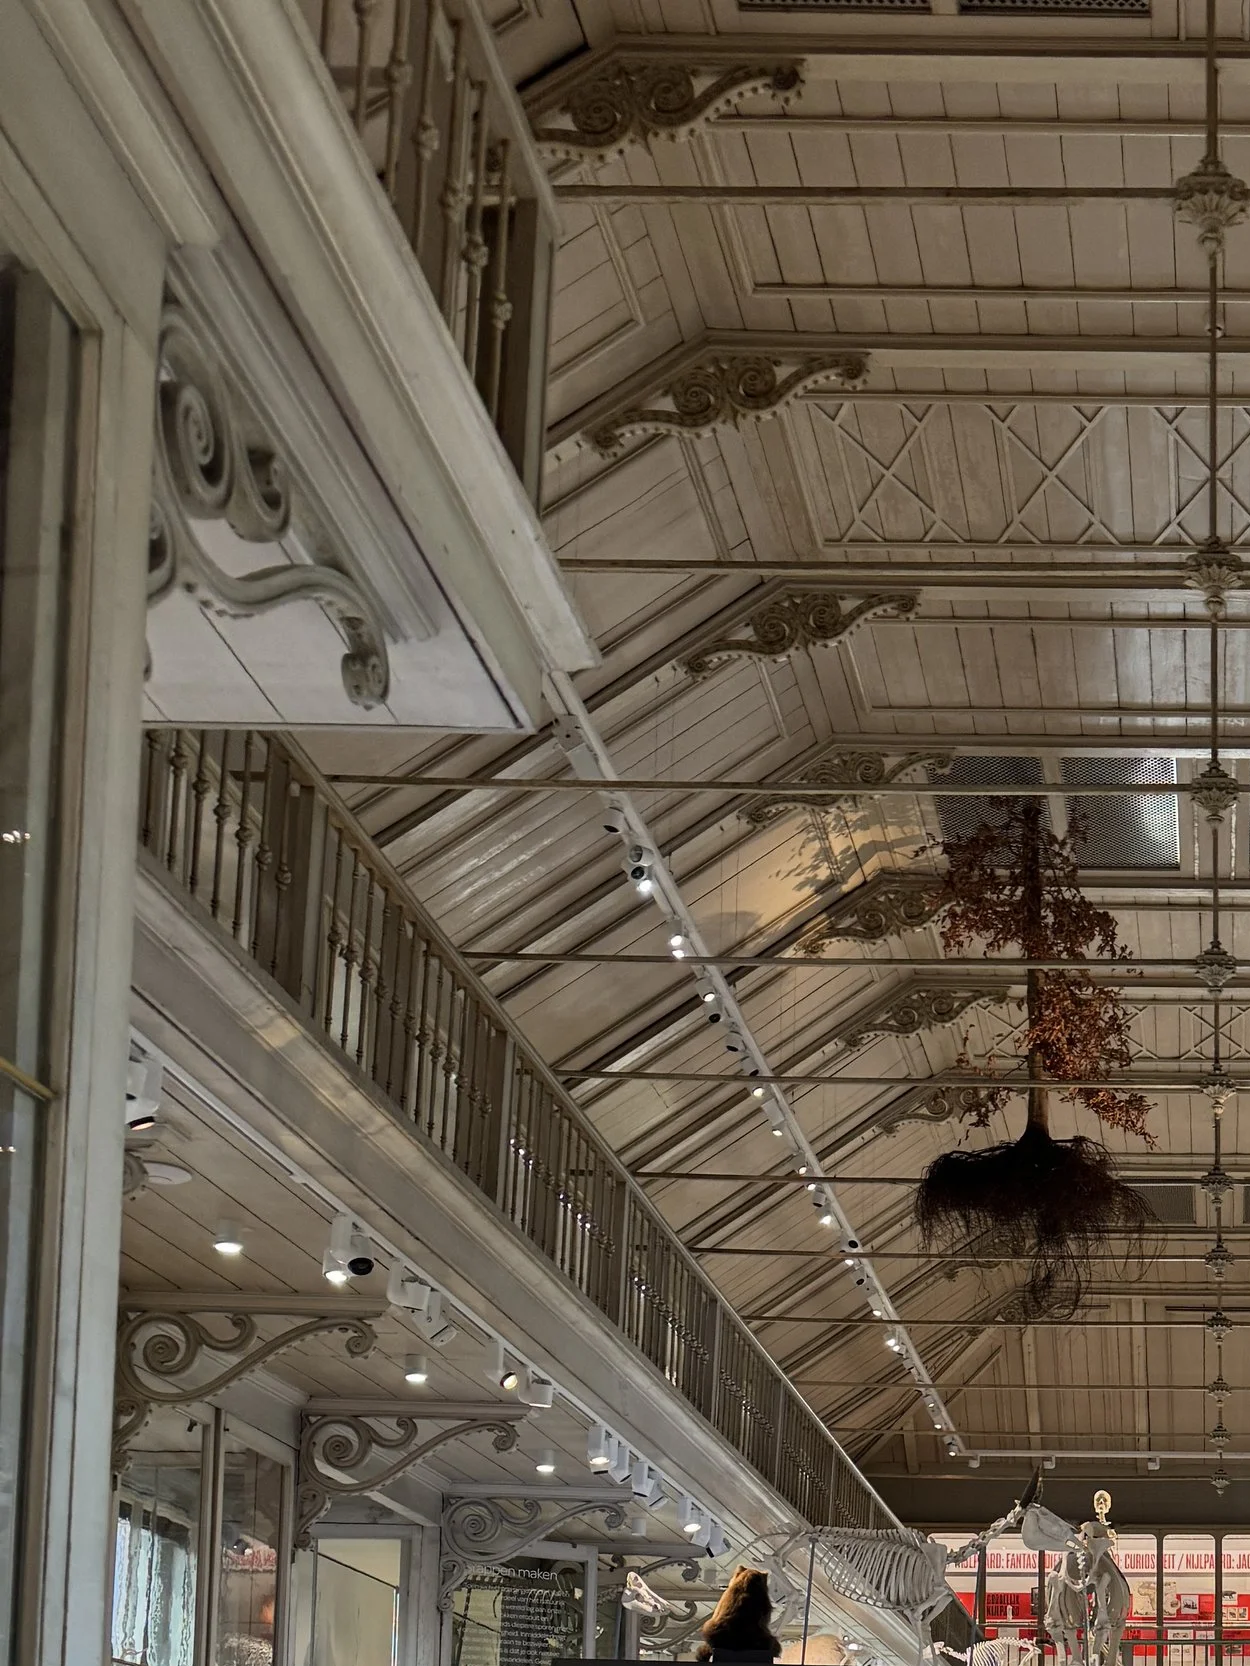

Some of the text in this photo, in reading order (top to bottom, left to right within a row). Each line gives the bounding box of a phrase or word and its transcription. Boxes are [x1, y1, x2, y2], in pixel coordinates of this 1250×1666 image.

[1124, 1553, 1176, 1569] CURIOSEIT
[1186, 1553, 1235, 1569] NIJLPARD:
[518, 1567, 558, 1581] maken
